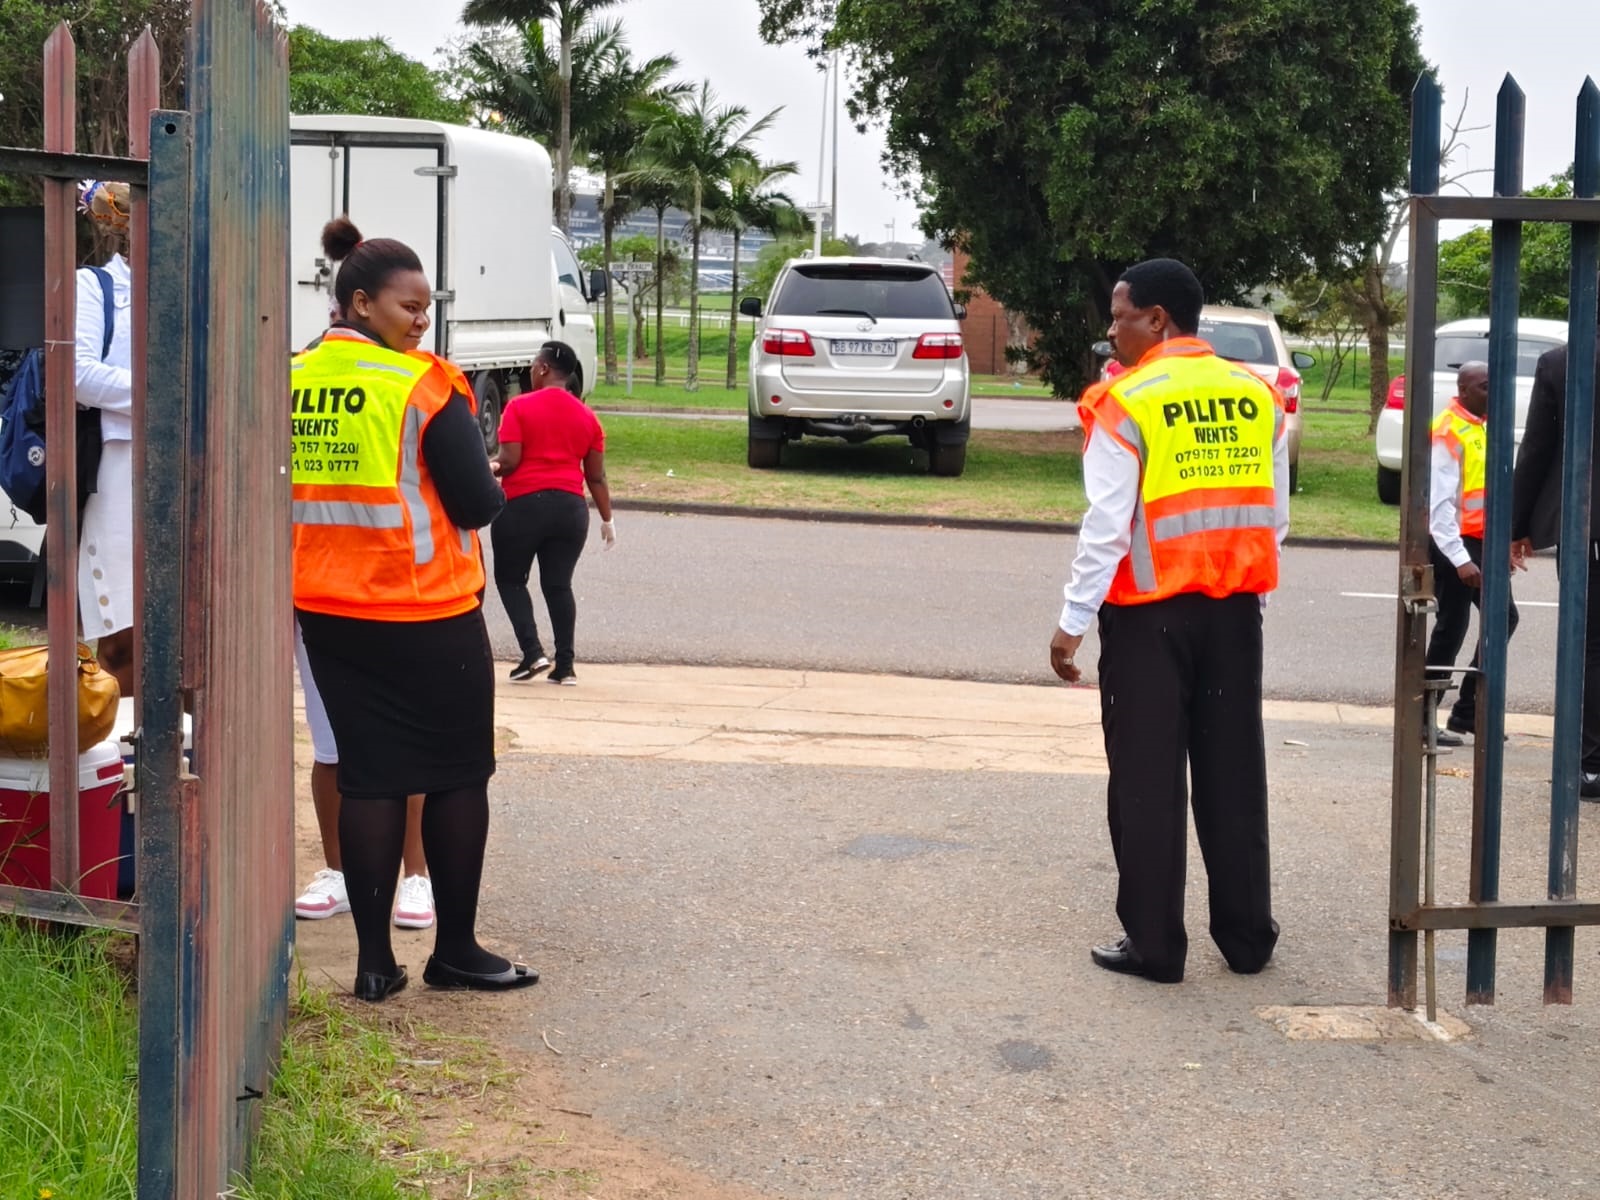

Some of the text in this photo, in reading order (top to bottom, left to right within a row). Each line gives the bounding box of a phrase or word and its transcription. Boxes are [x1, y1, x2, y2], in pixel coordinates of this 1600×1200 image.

[292, 387, 366, 415] ILITO
[1163, 397, 1258, 428] PILITO
[300, 442, 320, 453] 757
[304, 459, 323, 471] 023
[328, 460, 359, 472] 0777
[1229, 463, 1261, 475] 0777
